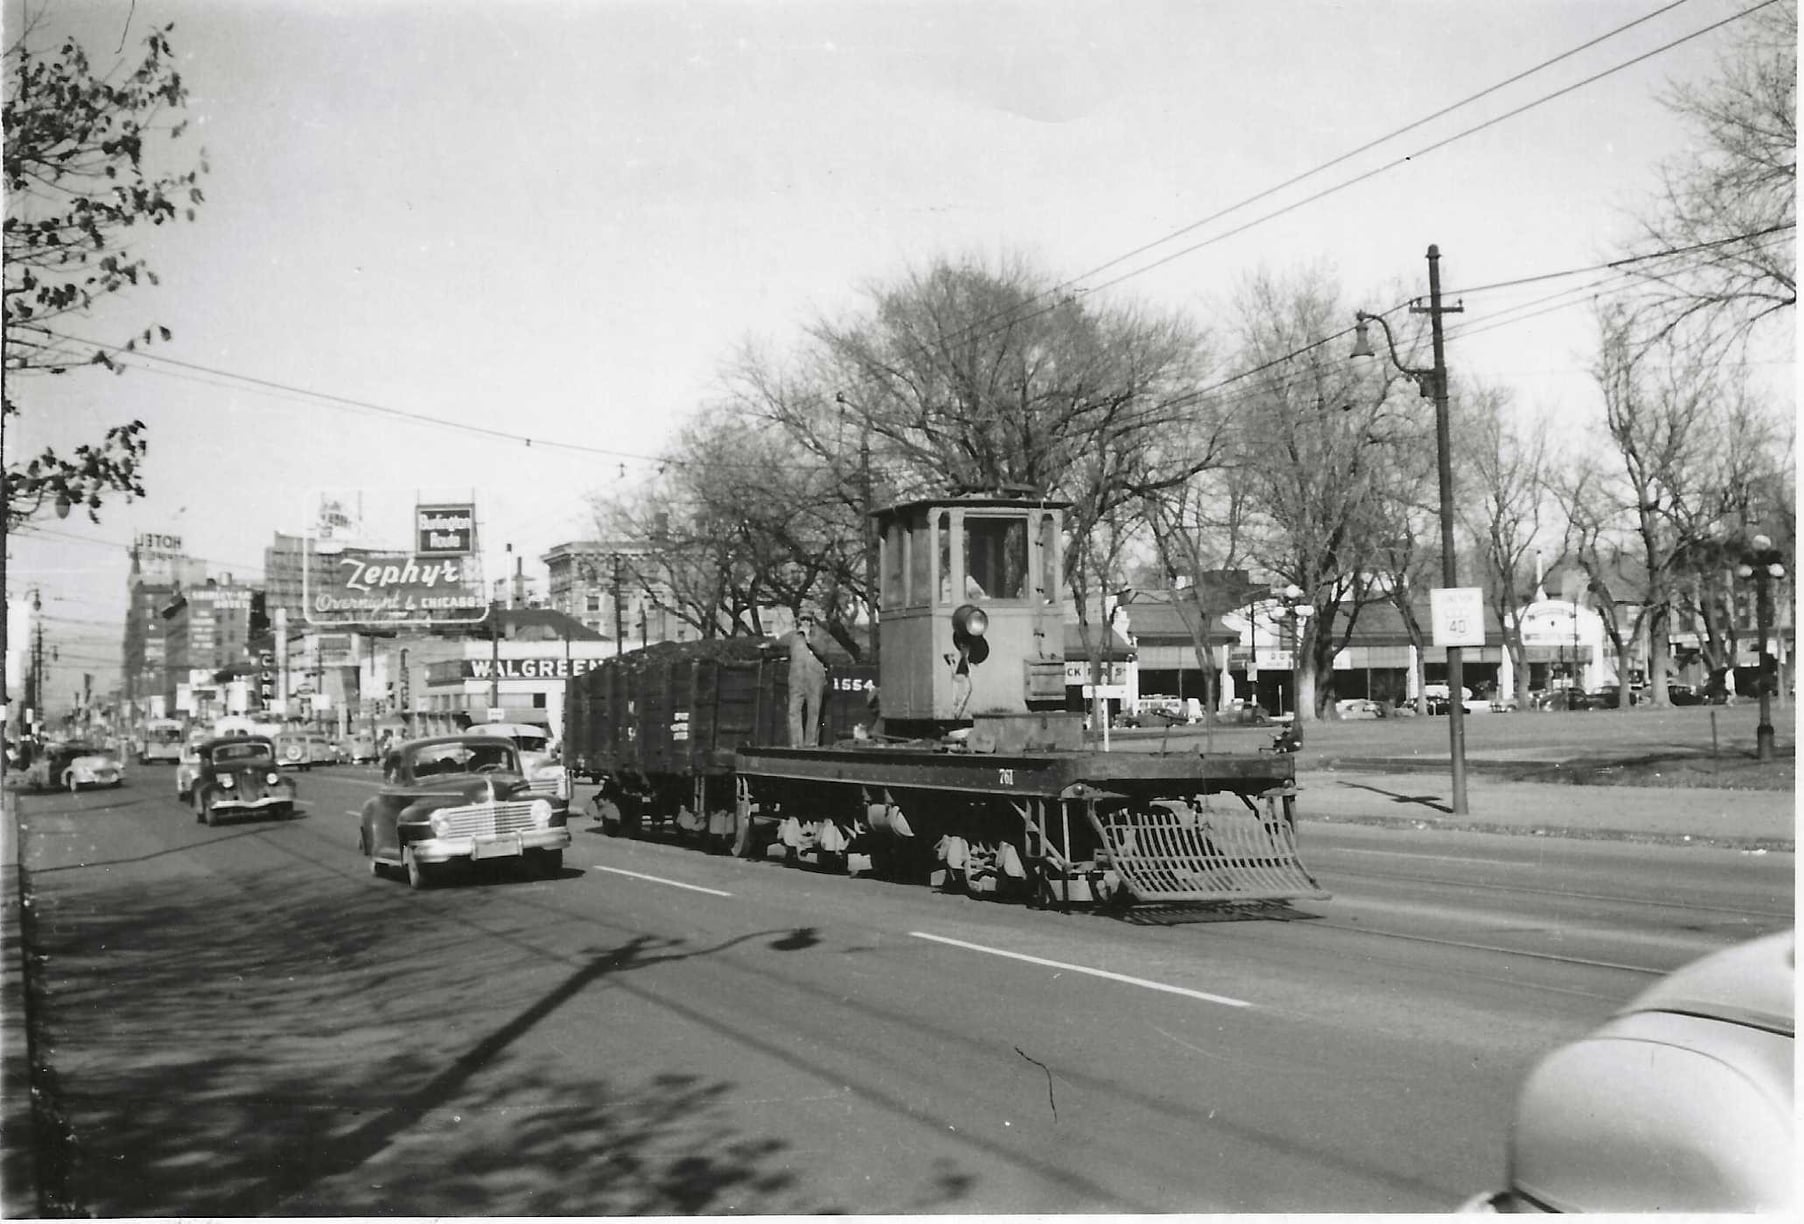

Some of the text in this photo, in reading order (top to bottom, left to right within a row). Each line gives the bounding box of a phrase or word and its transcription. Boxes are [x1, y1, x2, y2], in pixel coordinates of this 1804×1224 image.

[340, 558, 460, 592] Zephyr
[1449, 619, 1466, 634] 40
[833, 677, 876, 692] 1554
[999, 768, 1014, 785] 761
